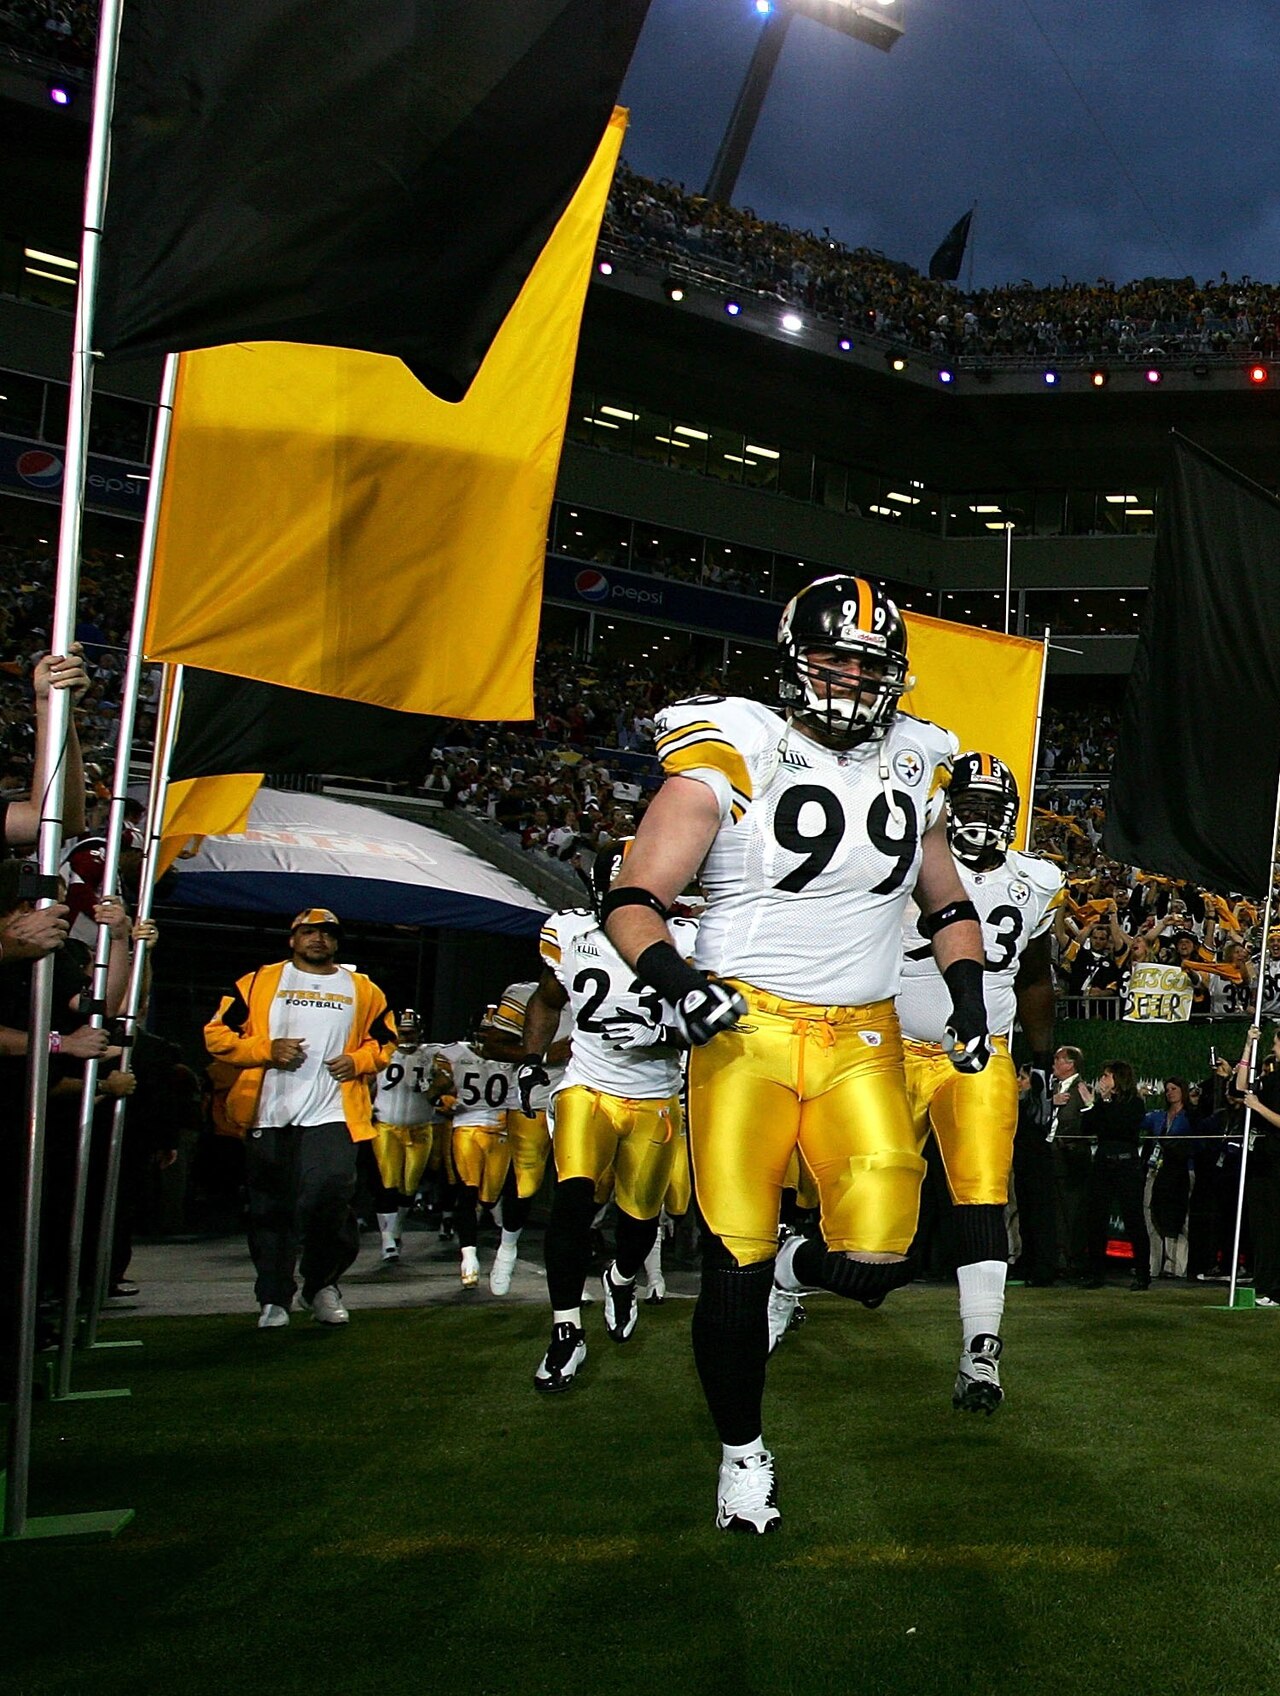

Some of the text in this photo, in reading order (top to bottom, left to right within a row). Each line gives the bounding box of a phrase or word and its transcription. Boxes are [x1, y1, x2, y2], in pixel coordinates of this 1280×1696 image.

[86, 474, 141, 495] epsi
[611, 585, 664, 604] pepsi
[772, 784, 917, 895] 99
[286, 999, 344, 1011] FOOTBALL
[462, 1072, 509, 1108] 50
